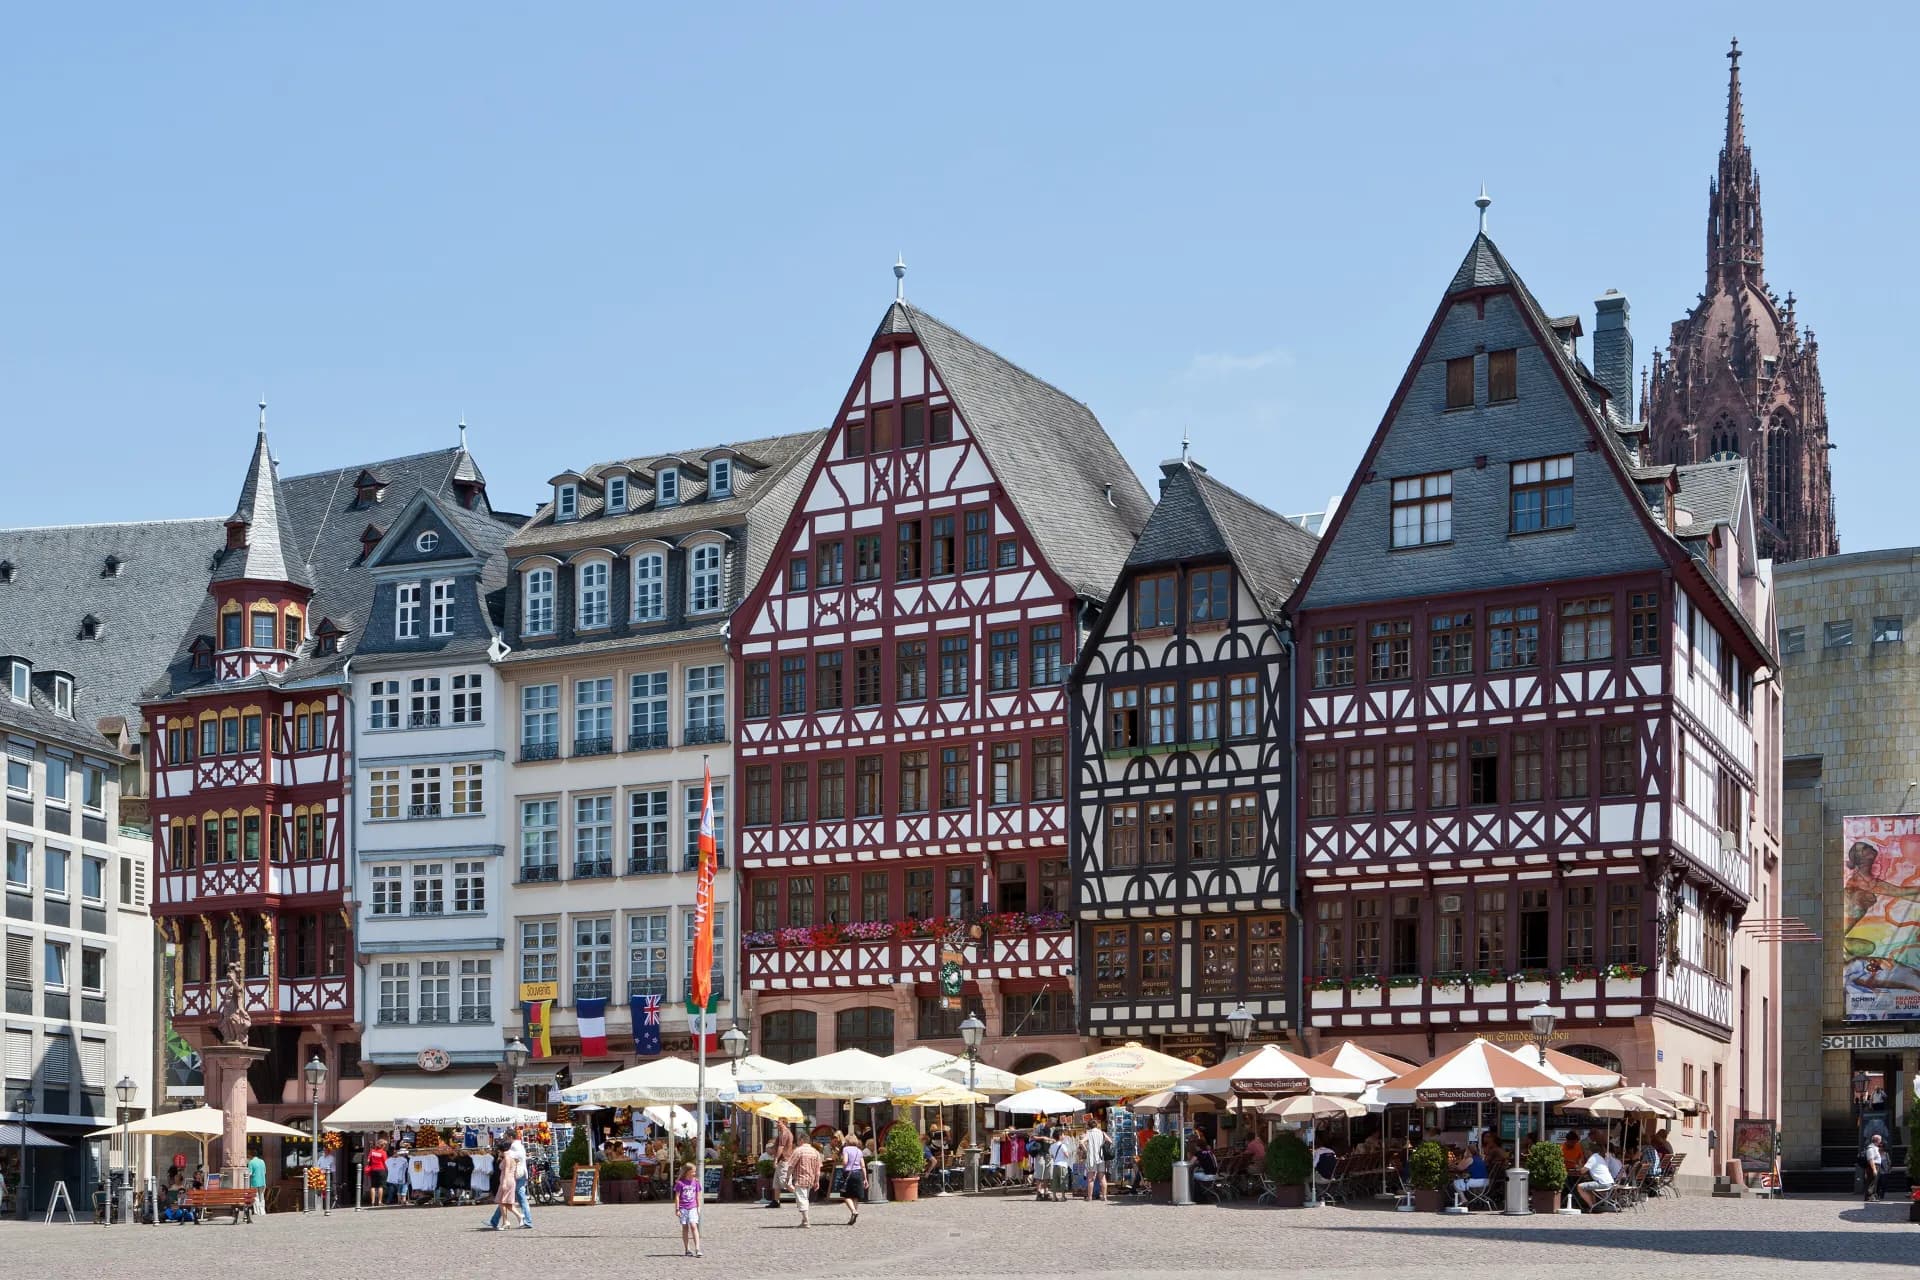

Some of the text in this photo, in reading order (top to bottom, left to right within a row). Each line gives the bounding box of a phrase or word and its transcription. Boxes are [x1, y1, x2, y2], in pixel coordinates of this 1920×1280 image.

[527, 984, 551, 997] Souvenirs
[1496, 1031, 1569, 1042] Standeschen
[1822, 1035, 1888, 1049] SCHIRN
[463, 1115, 511, 1124] Geschenke
